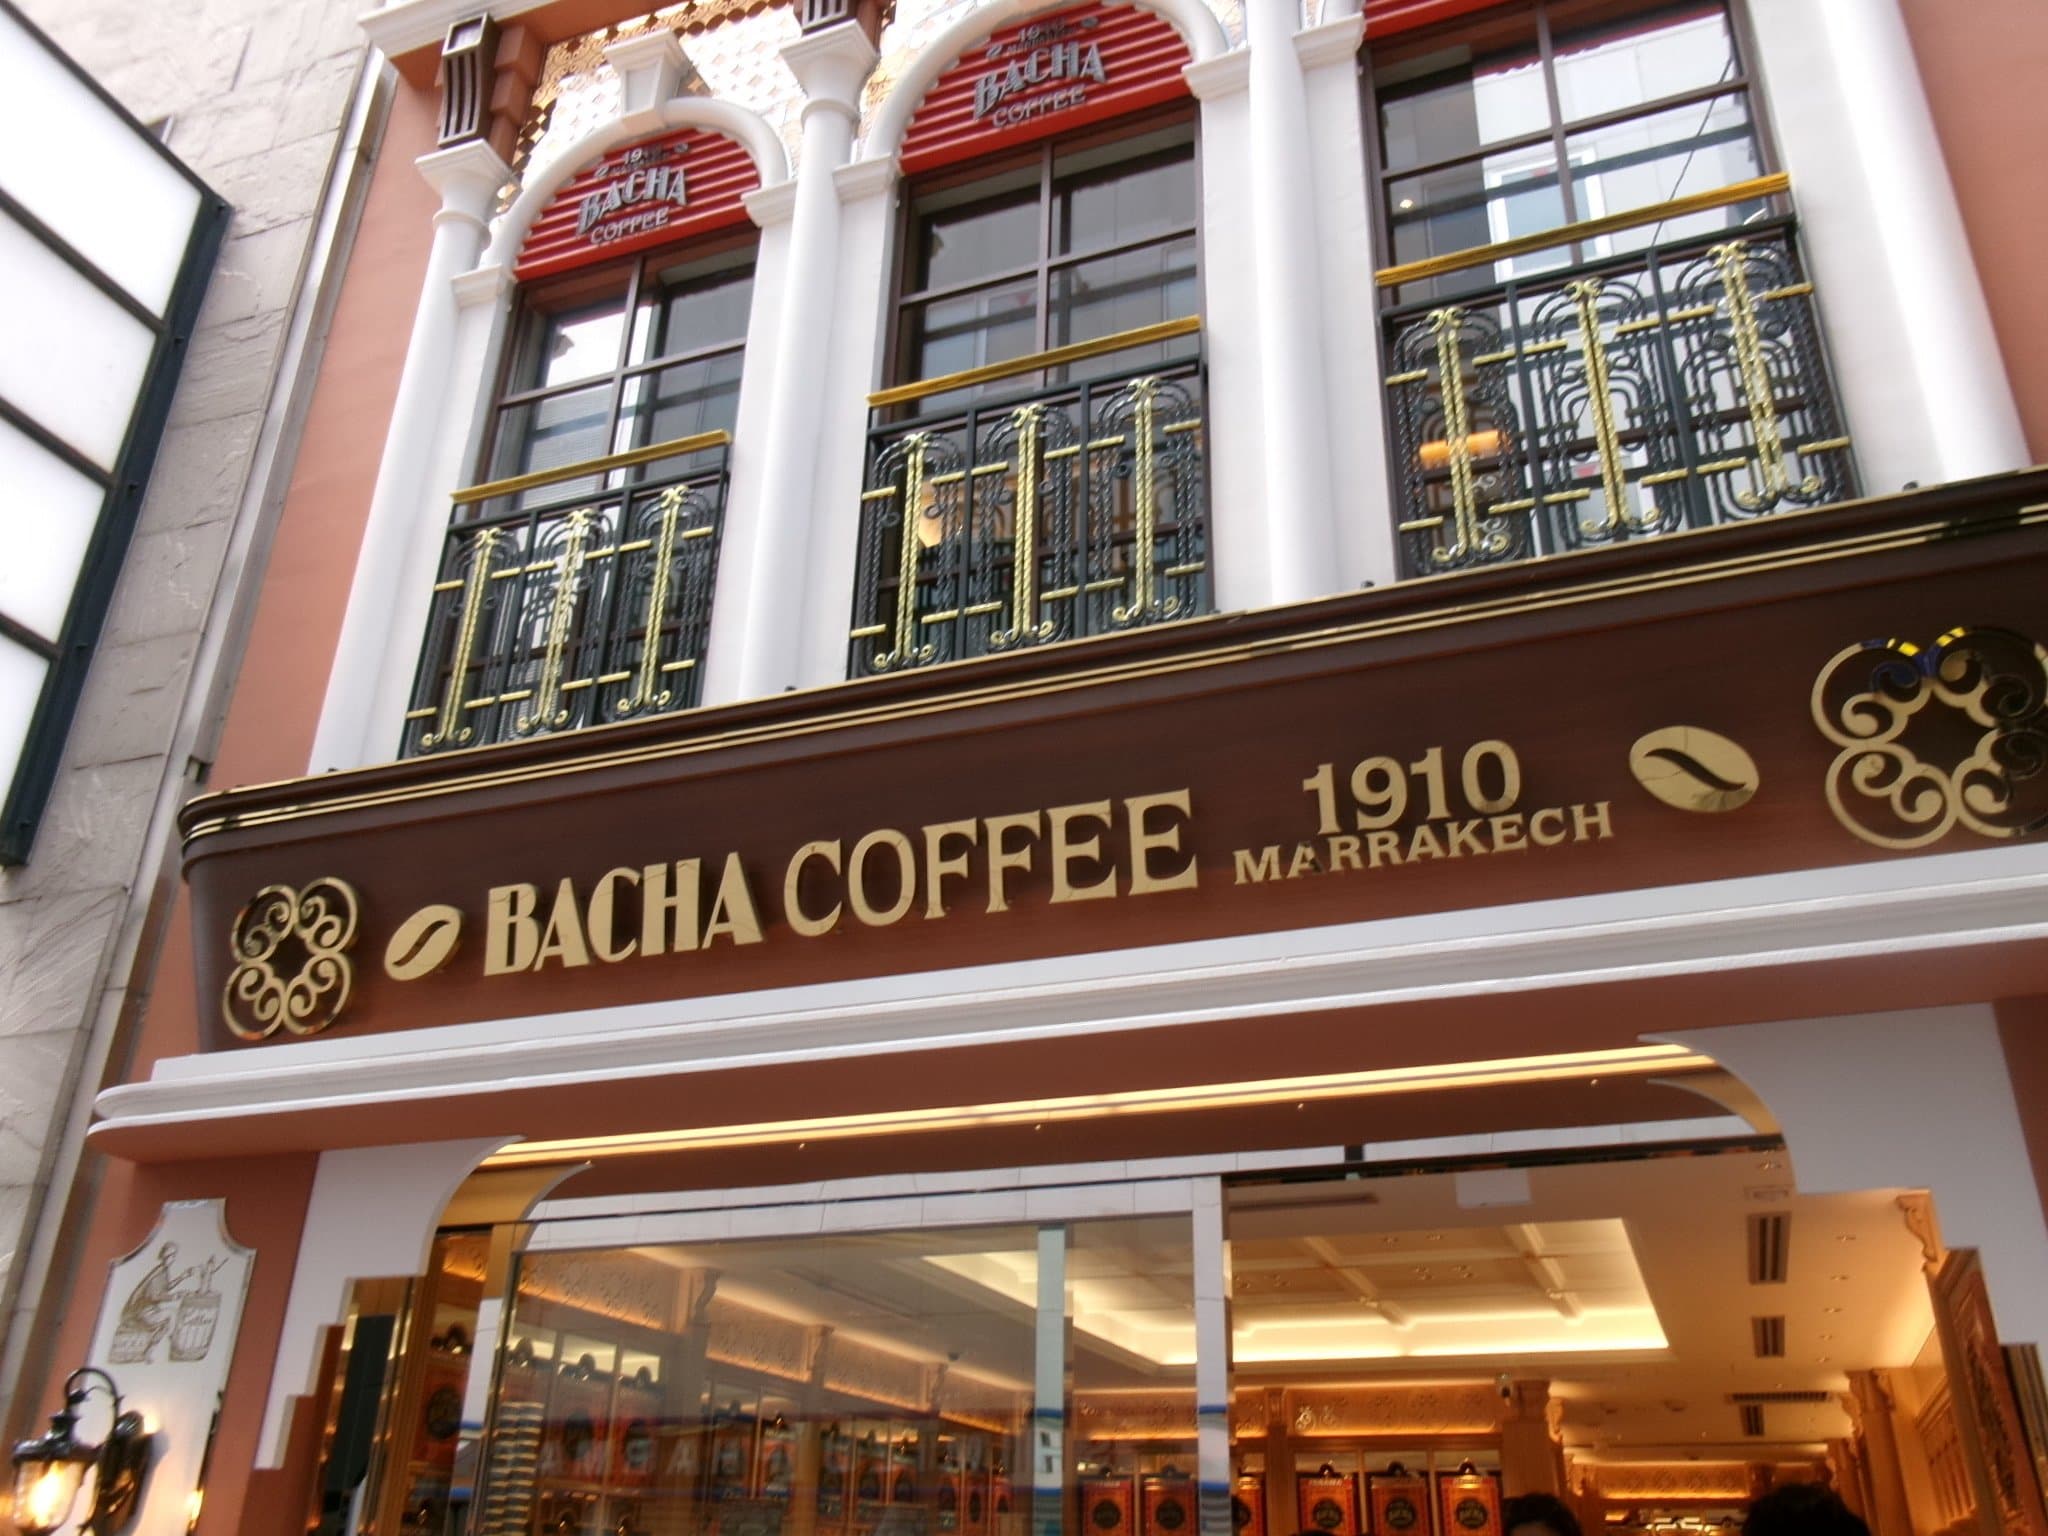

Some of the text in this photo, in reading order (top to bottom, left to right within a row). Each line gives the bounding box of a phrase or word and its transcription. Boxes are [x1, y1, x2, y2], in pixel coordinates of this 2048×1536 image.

[973, 41, 1106, 121] BACHA
[993, 84, 1086, 127] COFFEE
[576, 166, 687, 236] BACHA
[590, 206, 669, 244] COFFEE
[1303, 739, 1521, 835] 1910
[482, 789, 1199, 976] BACHA COFFEE
[1233, 801, 1614, 885] MARRAKECH
